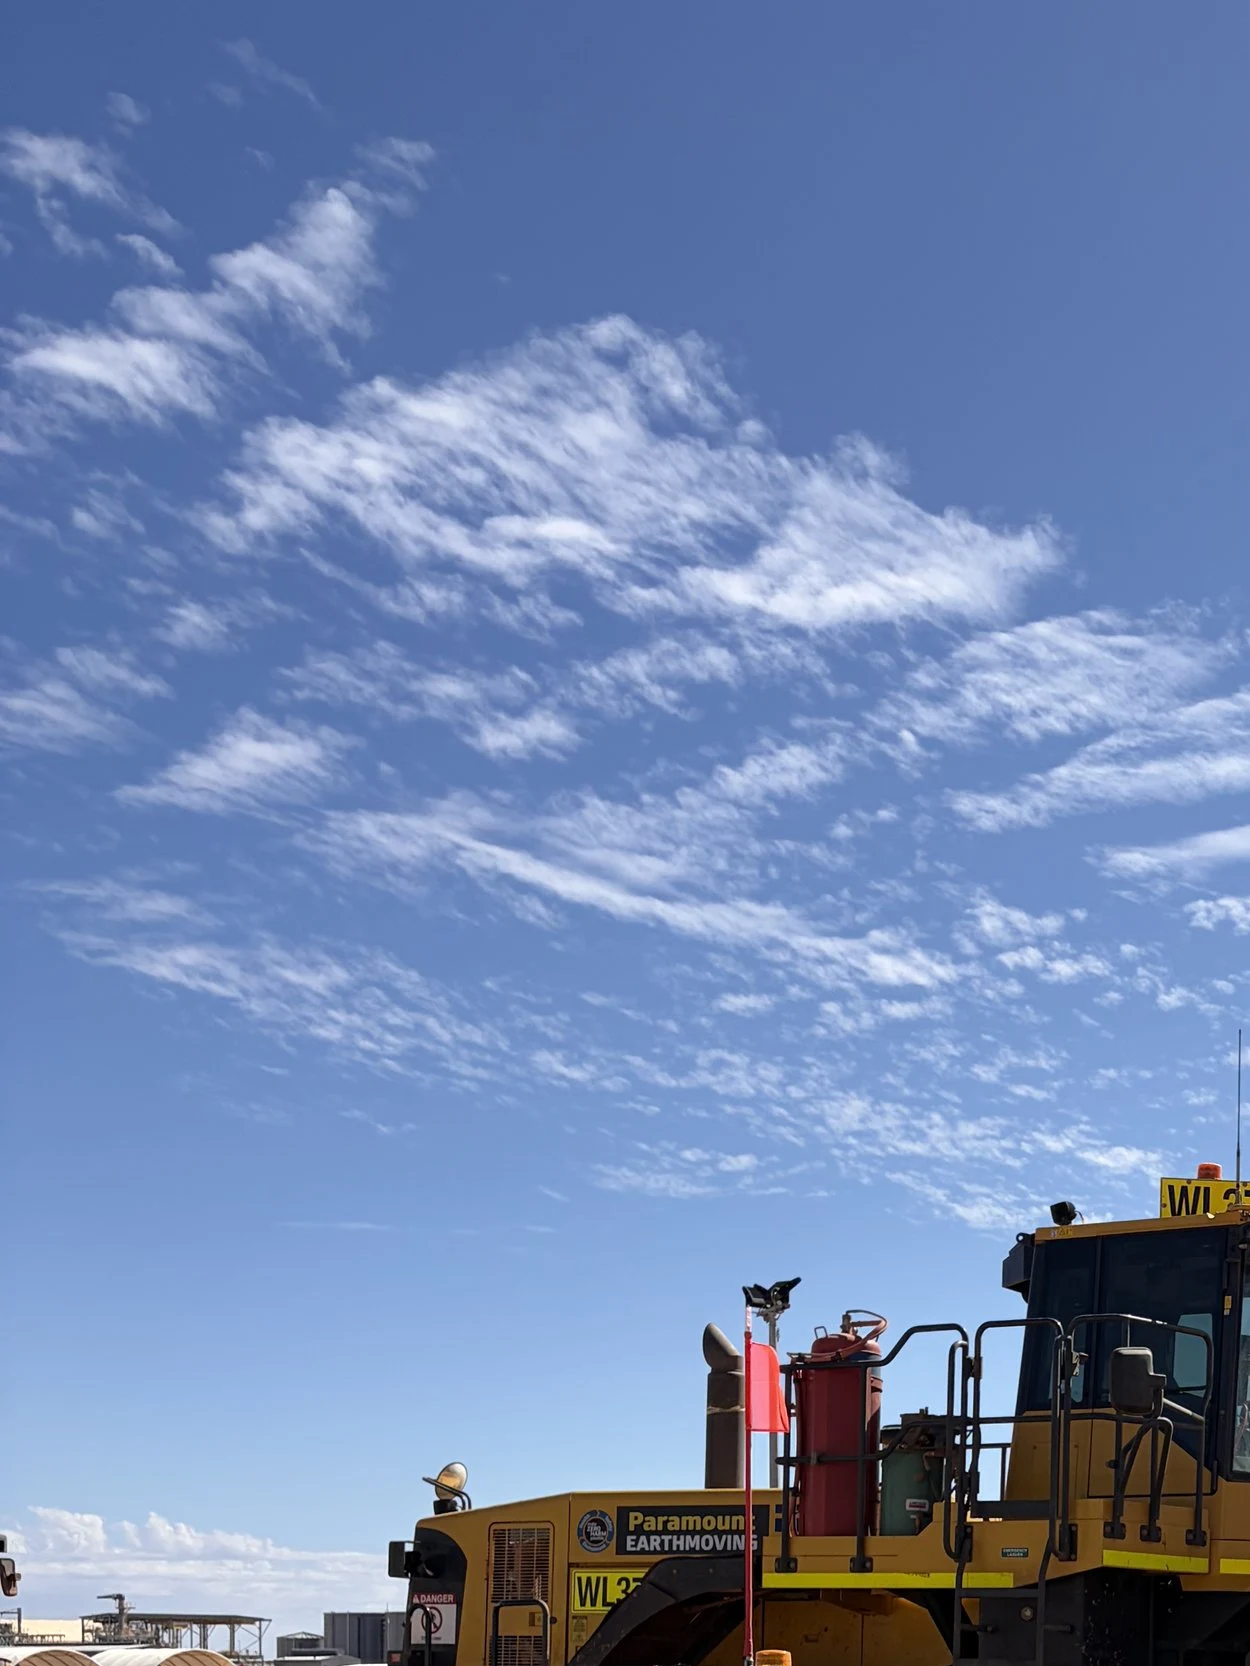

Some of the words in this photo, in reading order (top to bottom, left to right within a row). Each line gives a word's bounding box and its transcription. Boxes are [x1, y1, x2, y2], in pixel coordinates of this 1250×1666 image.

[626, 1534, 758, 1552] EARTHMOVING
[420, 1594, 454, 1603] DANGER
[576, 1576, 644, 1608] WL3
